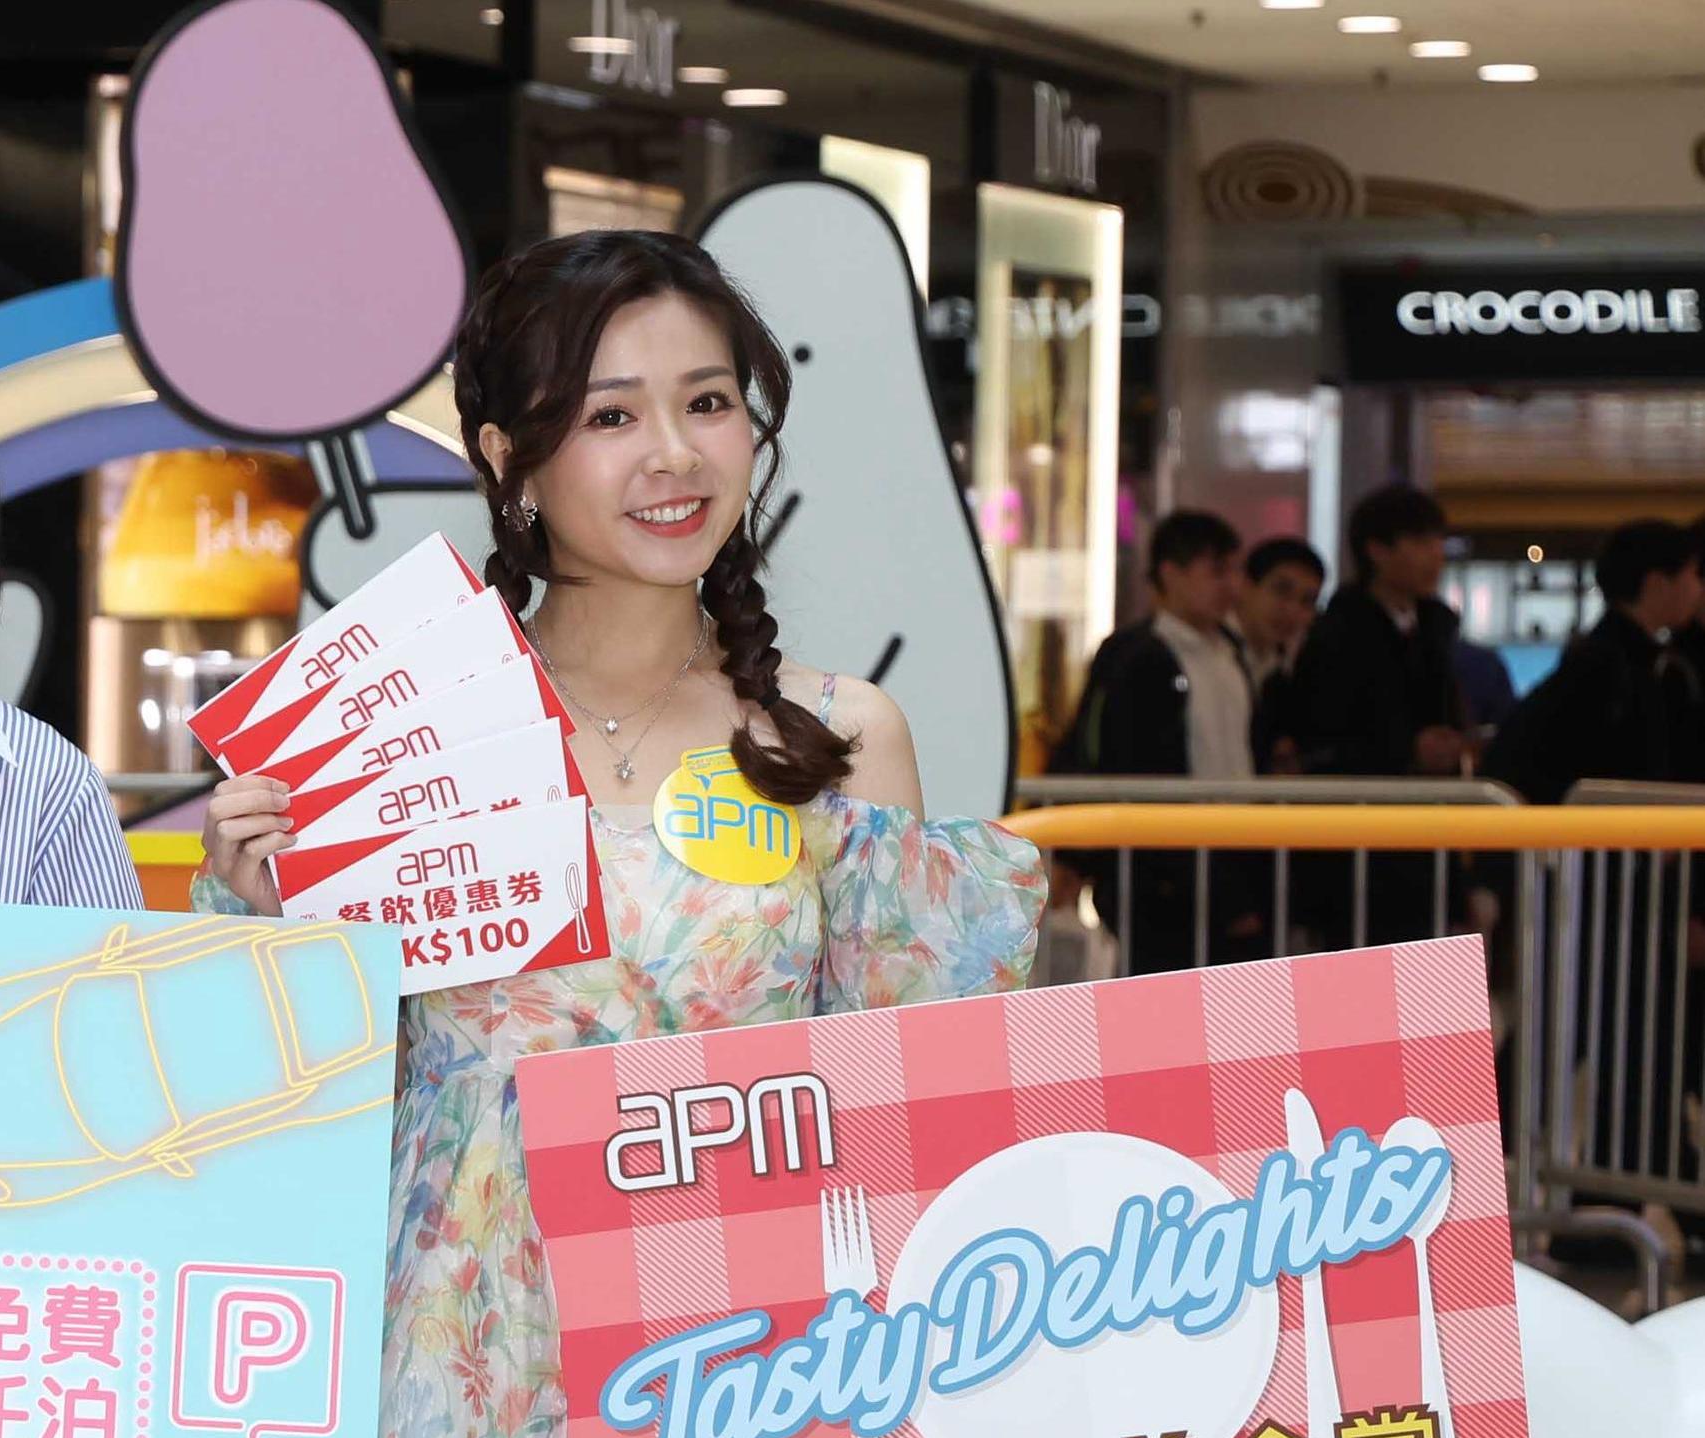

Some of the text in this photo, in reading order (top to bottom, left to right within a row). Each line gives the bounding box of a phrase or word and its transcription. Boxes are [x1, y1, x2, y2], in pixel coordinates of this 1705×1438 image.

[1396, 288, 1702, 335] CROCODILE
[401, 917, 530, 968] K$100
[929, 1127, 1453, 1394] Delights
[213, 1290, 308, 1406] P
